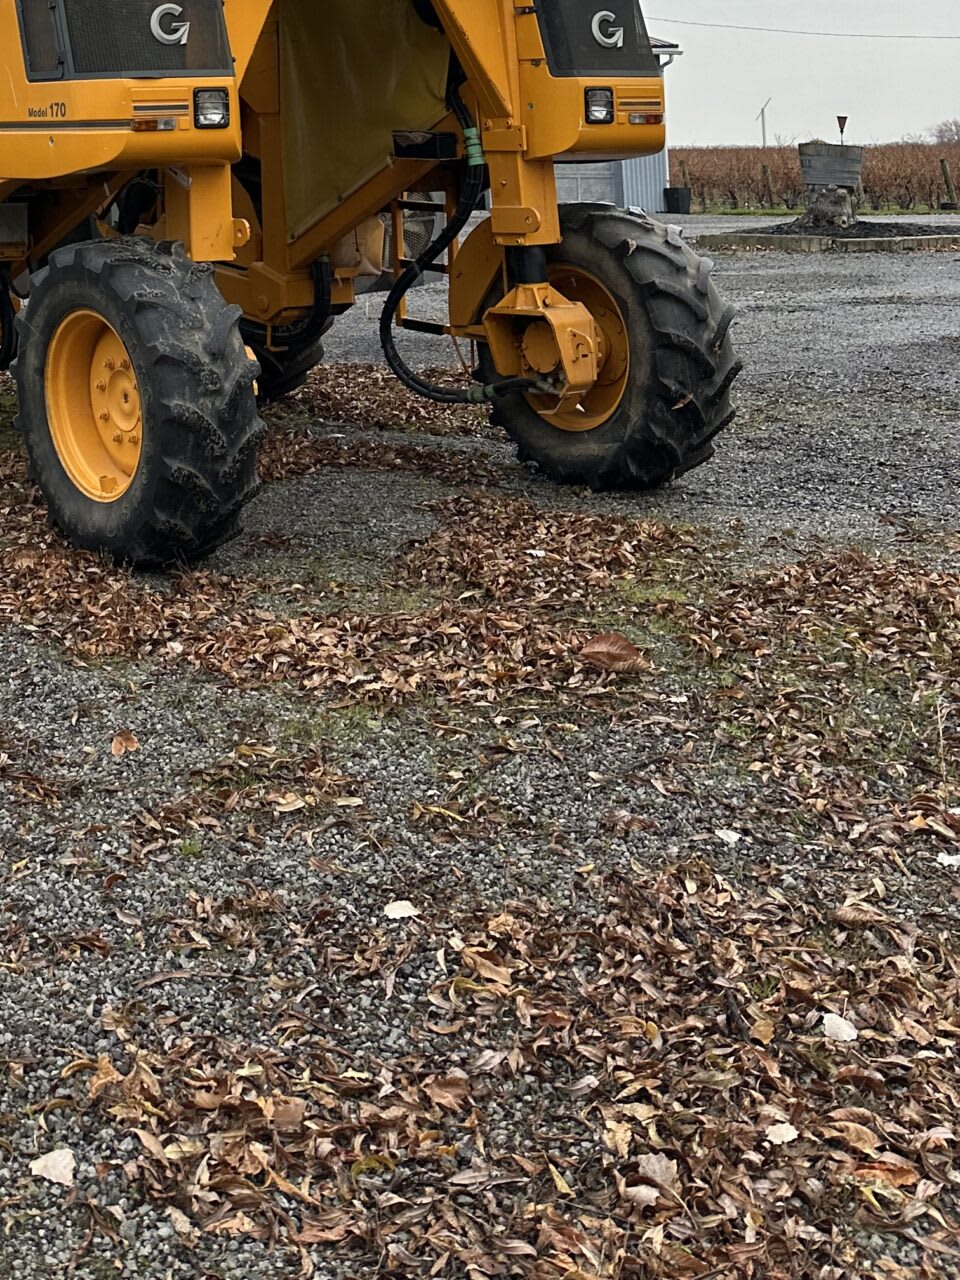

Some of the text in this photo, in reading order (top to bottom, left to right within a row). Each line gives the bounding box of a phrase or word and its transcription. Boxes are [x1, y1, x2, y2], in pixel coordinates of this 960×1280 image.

[150, 3, 190, 45] G
[591, 10, 624, 48] G
[28, 102, 66, 118] Model 170
